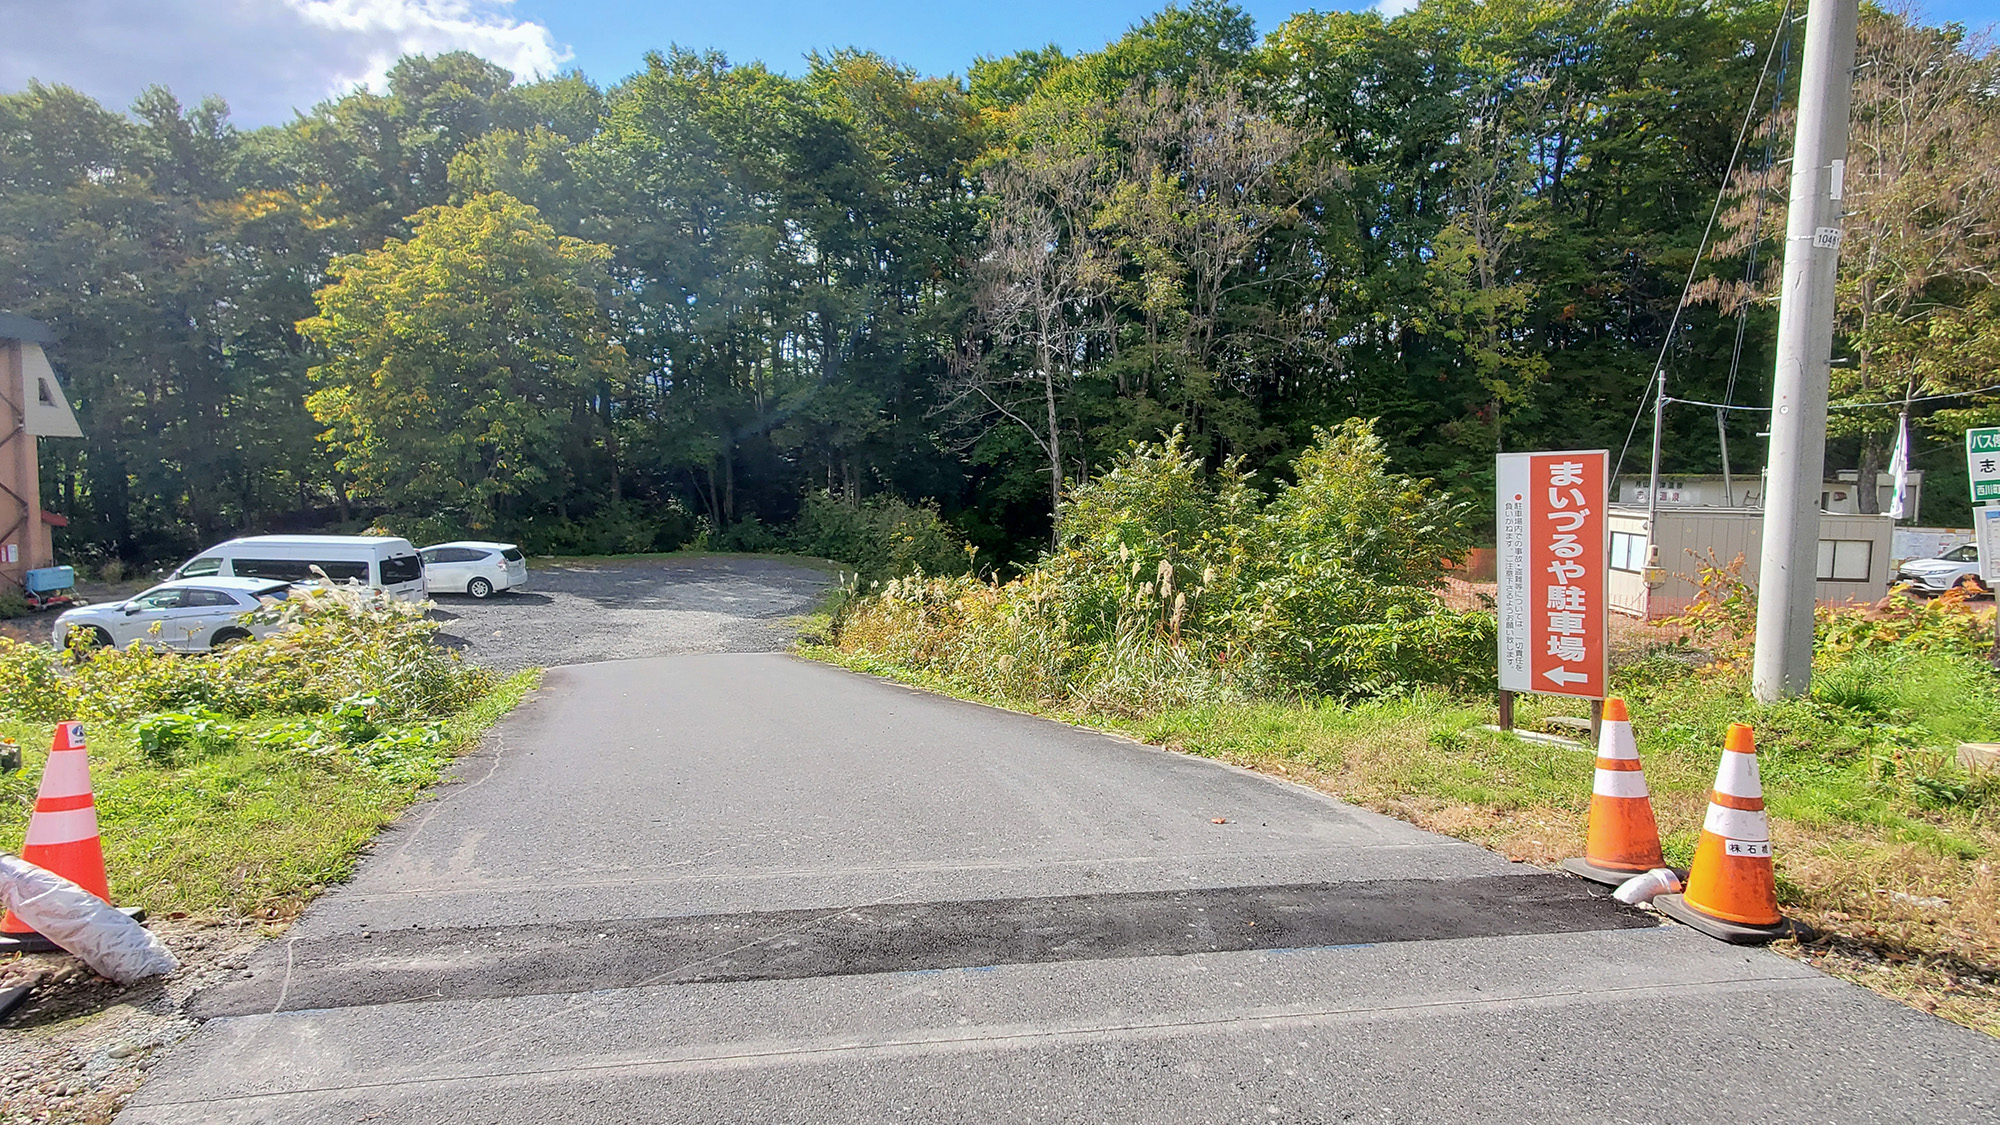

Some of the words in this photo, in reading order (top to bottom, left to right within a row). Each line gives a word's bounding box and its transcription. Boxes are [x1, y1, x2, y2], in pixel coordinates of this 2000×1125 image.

[1979, 458, 1996, 474] 志
[1546, 461, 1591, 663] まいづるや駐車場
